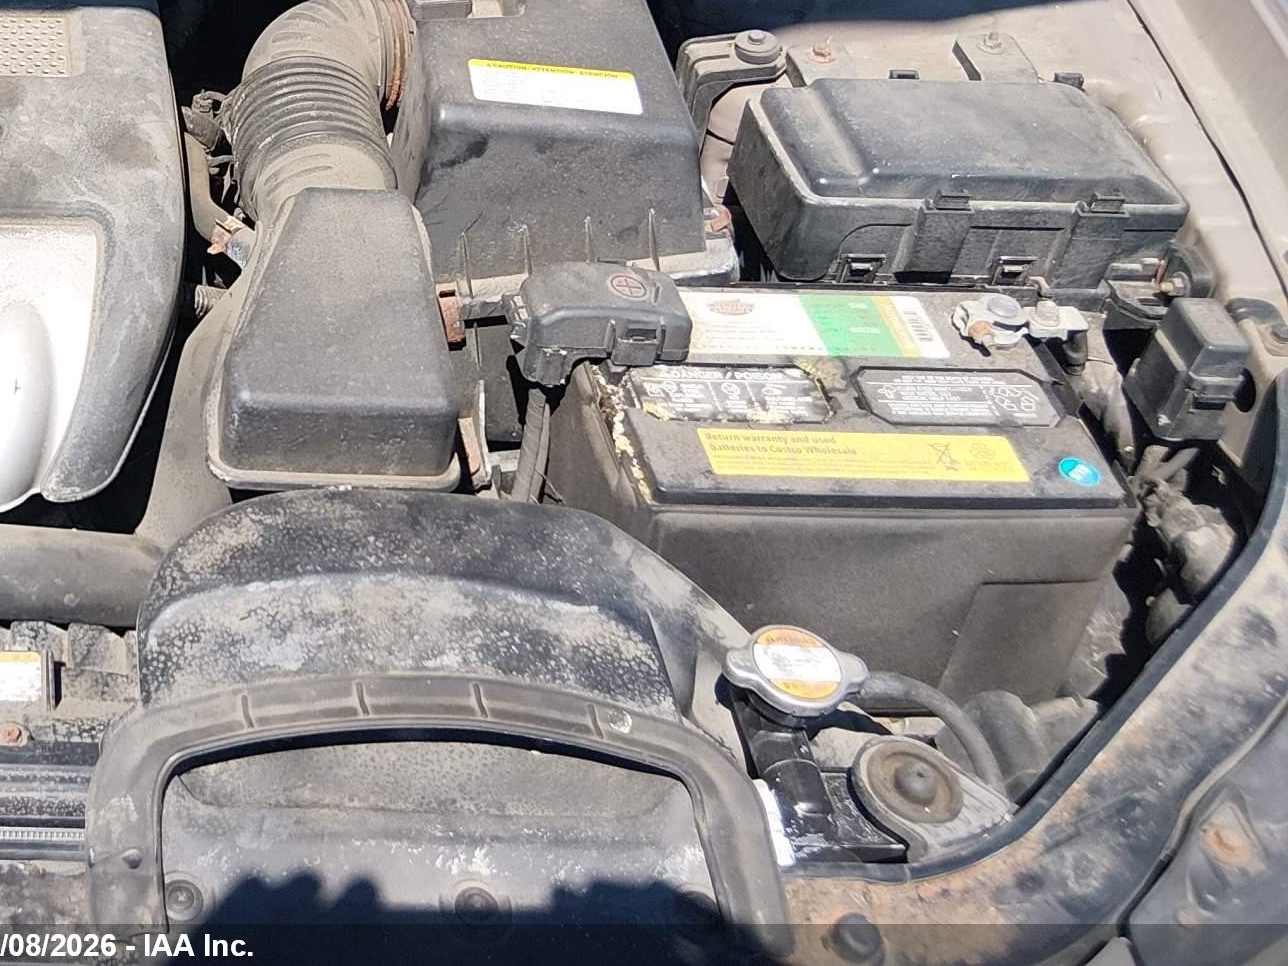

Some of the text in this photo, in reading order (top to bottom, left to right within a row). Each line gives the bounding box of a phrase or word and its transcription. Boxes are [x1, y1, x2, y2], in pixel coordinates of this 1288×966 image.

[671, 370, 723, 380] DANGER
[734, 371, 784, 381] POISON
[705, 432, 836, 445] Return warranty and used
[710, 443, 857, 455] batteries to Costco Wholesale
